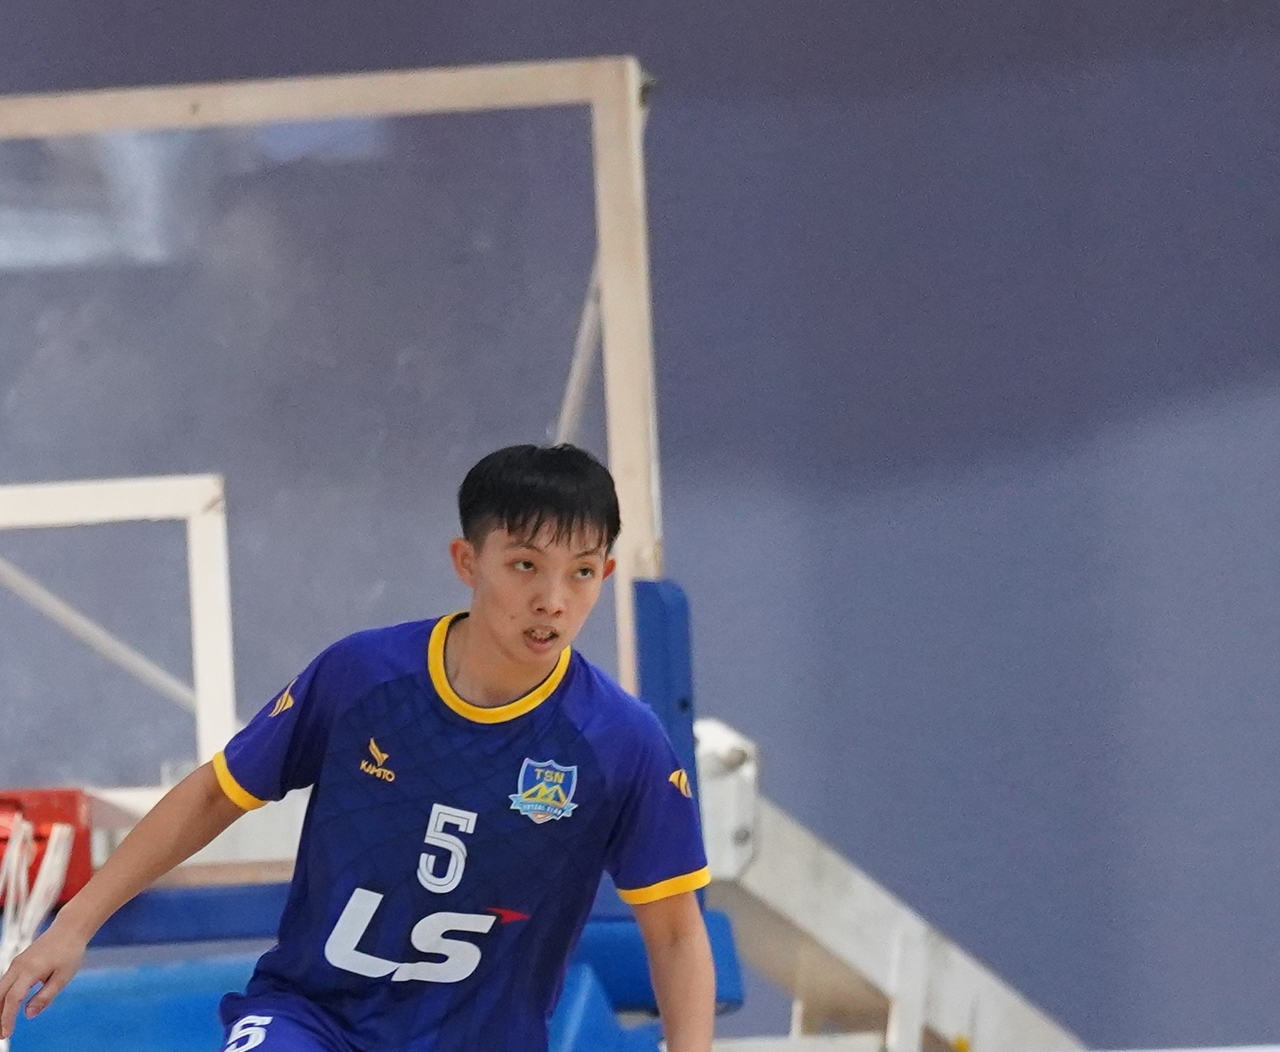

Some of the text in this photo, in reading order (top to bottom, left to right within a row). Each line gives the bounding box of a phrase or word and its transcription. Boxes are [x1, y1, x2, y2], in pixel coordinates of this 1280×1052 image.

[359, 759, 396, 782] KAMITO
[534, 767, 565, 784] TSN
[416, 803, 478, 894] 5
[324, 887, 498, 984] LS
